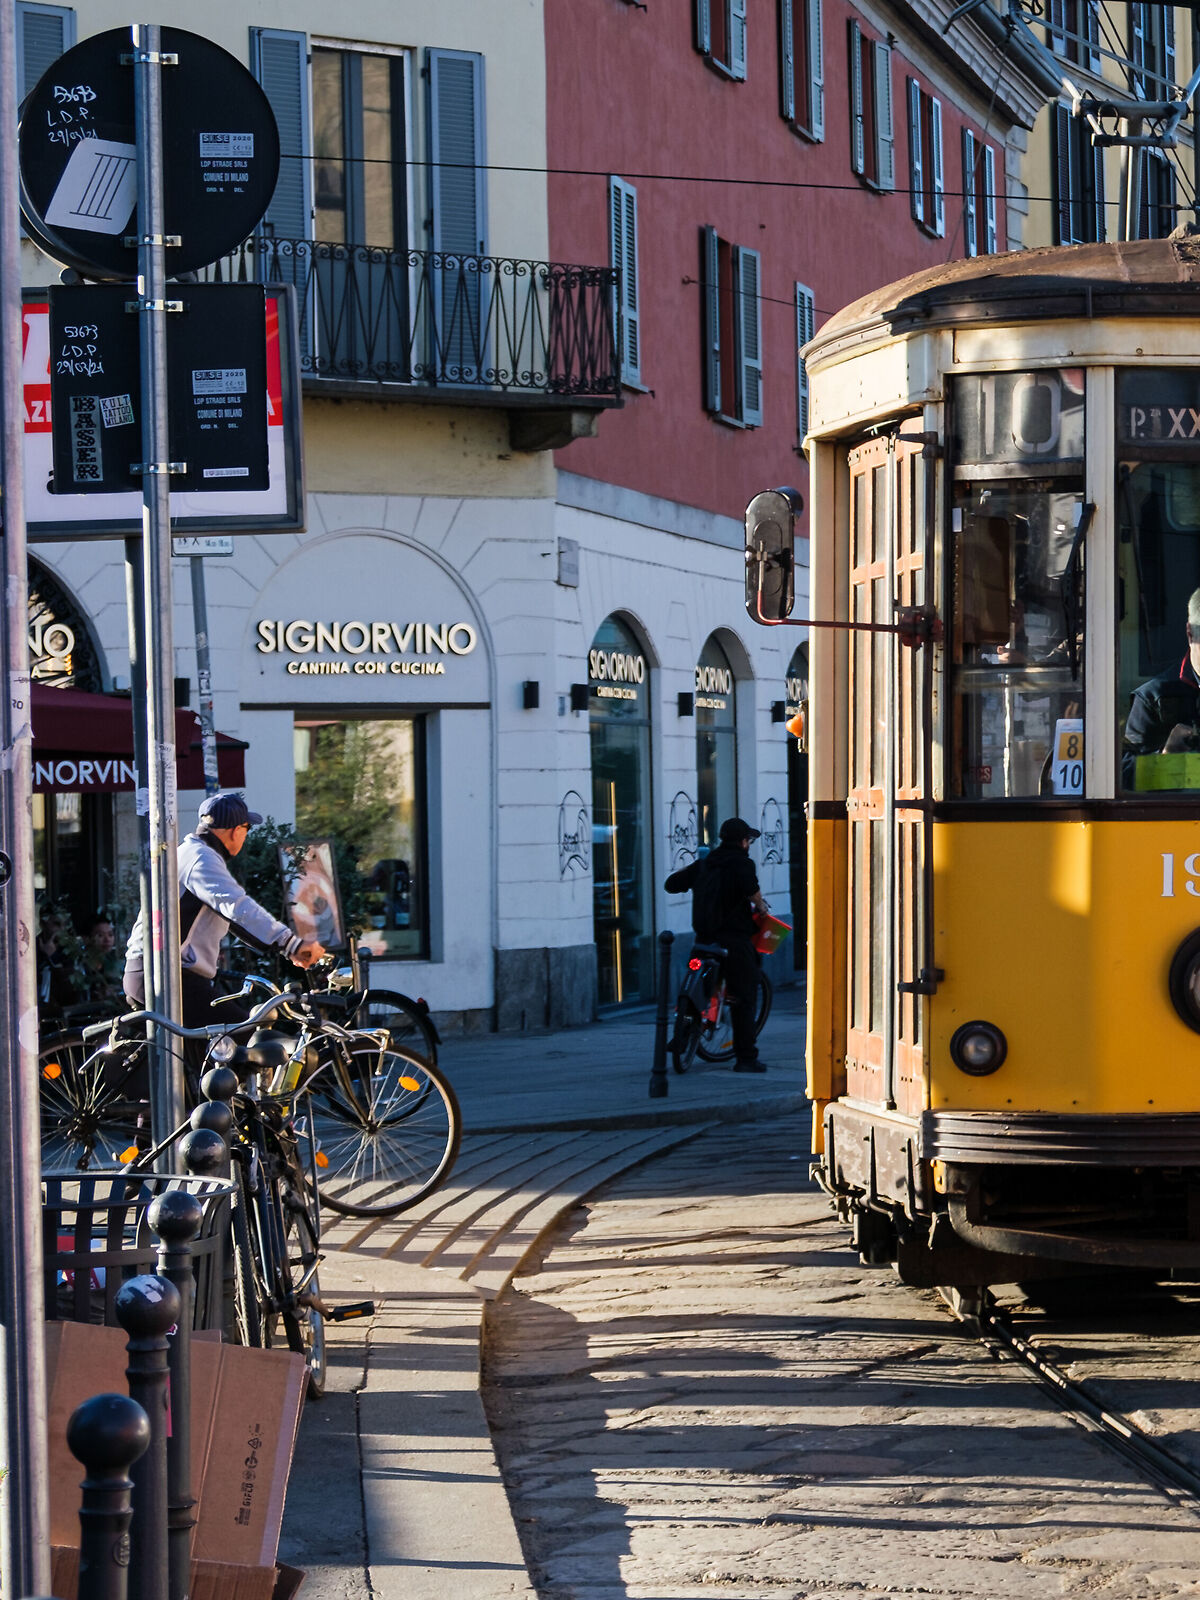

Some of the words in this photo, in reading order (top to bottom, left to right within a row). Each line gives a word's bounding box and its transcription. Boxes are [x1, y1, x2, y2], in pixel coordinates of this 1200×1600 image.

[102, 396, 129, 410] KULT
[205, 396, 226, 404] STRADE
[103, 406, 131, 418] TATTOO
[106, 413, 133, 426] MILANO
[224, 408, 243, 418] MILANO
[983, 374, 1061, 455] 10
[256, 619, 478, 656] SIGNORVINO
[286, 661, 351, 675] CANTINA
[353, 661, 387, 675] CON
[389, 661, 446, 676] CUCINA
[589, 649, 645, 684] SIGNORVINO
[1066, 735, 1079, 759] 8
[31, 760, 137, 785] NORVIN
[1059, 764, 1081, 789] 10
